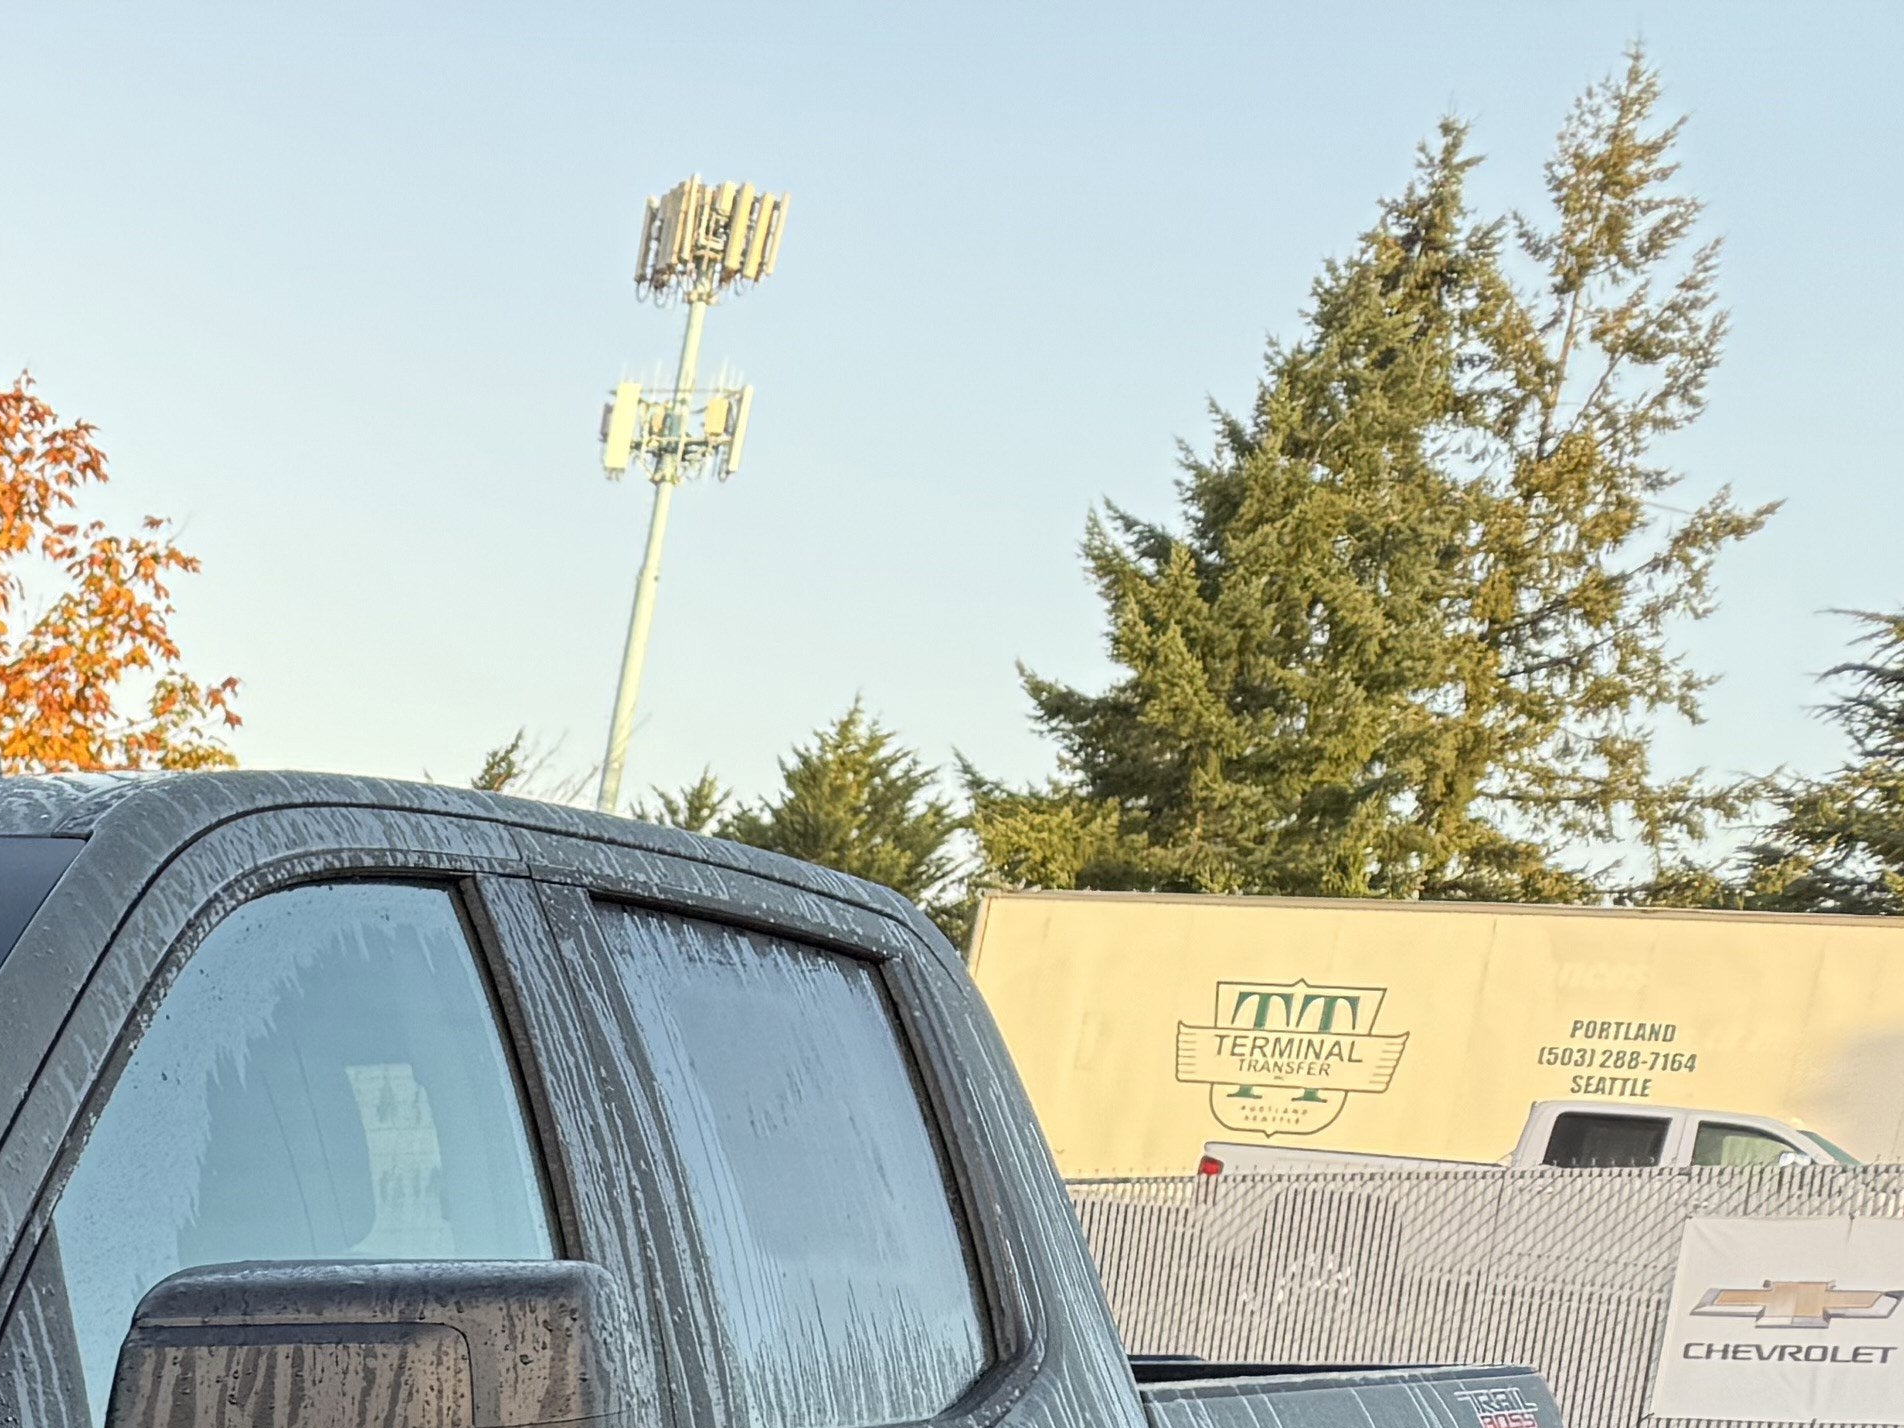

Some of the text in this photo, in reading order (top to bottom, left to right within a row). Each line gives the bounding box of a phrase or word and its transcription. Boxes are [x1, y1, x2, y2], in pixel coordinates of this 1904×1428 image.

[1570, 1019, 1677, 1043] PORTLAND
[1214, 1033, 1364, 1064] TERMINAL
[1537, 1046, 1698, 1073] (503) 288-7164
[1237, 1057, 1332, 1077] TRANSFER
[1570, 1074, 1653, 1098] SEATTLE
[1682, 1342, 1899, 1365] CHEVROLET
[1453, 1387, 1539, 1413] TRAIL
